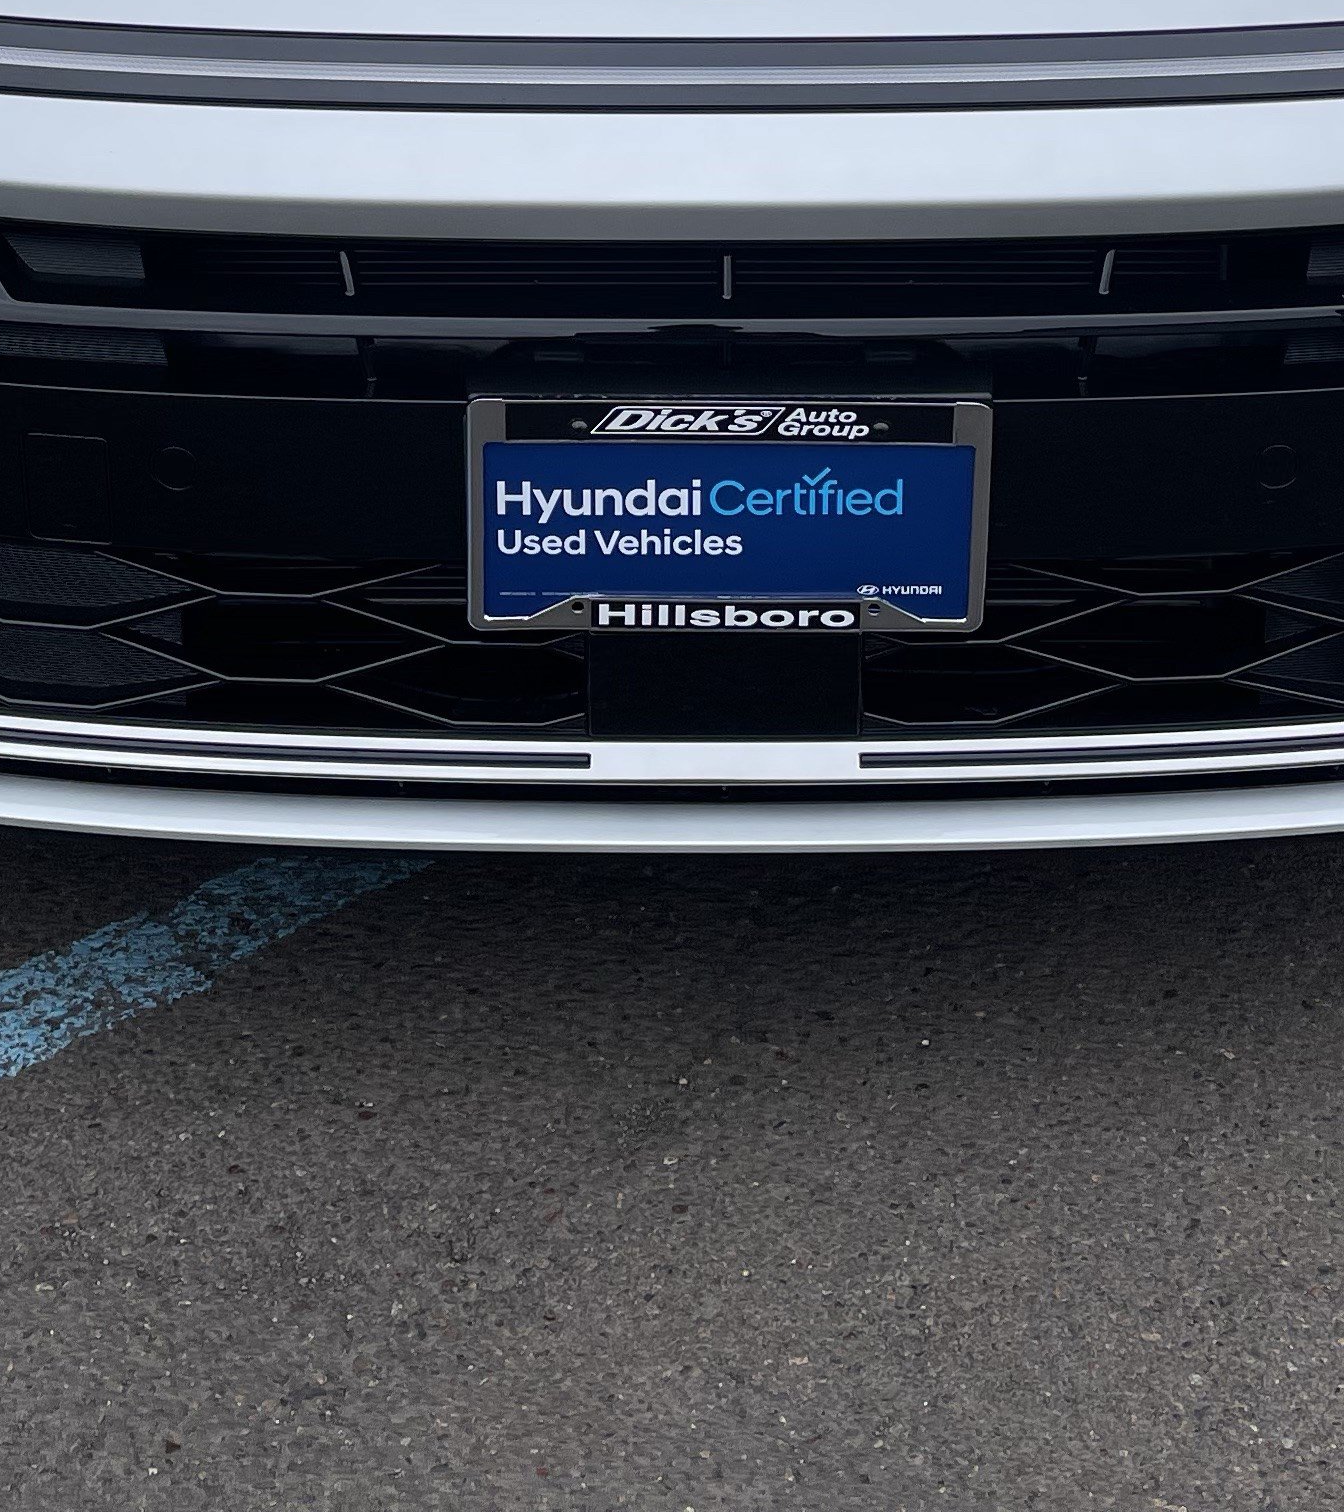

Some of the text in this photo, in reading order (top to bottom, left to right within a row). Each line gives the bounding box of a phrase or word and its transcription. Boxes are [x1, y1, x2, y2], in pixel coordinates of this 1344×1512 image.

[784, 408, 858, 423] Auto
[778, 421, 870, 439] Group
[496, 467, 904, 524] Hyundai Certified
[496, 529, 744, 556] Used Vehicles
[882, 585, 943, 595] HYUNDAI
[598, 604, 856, 628] Hillsboro
